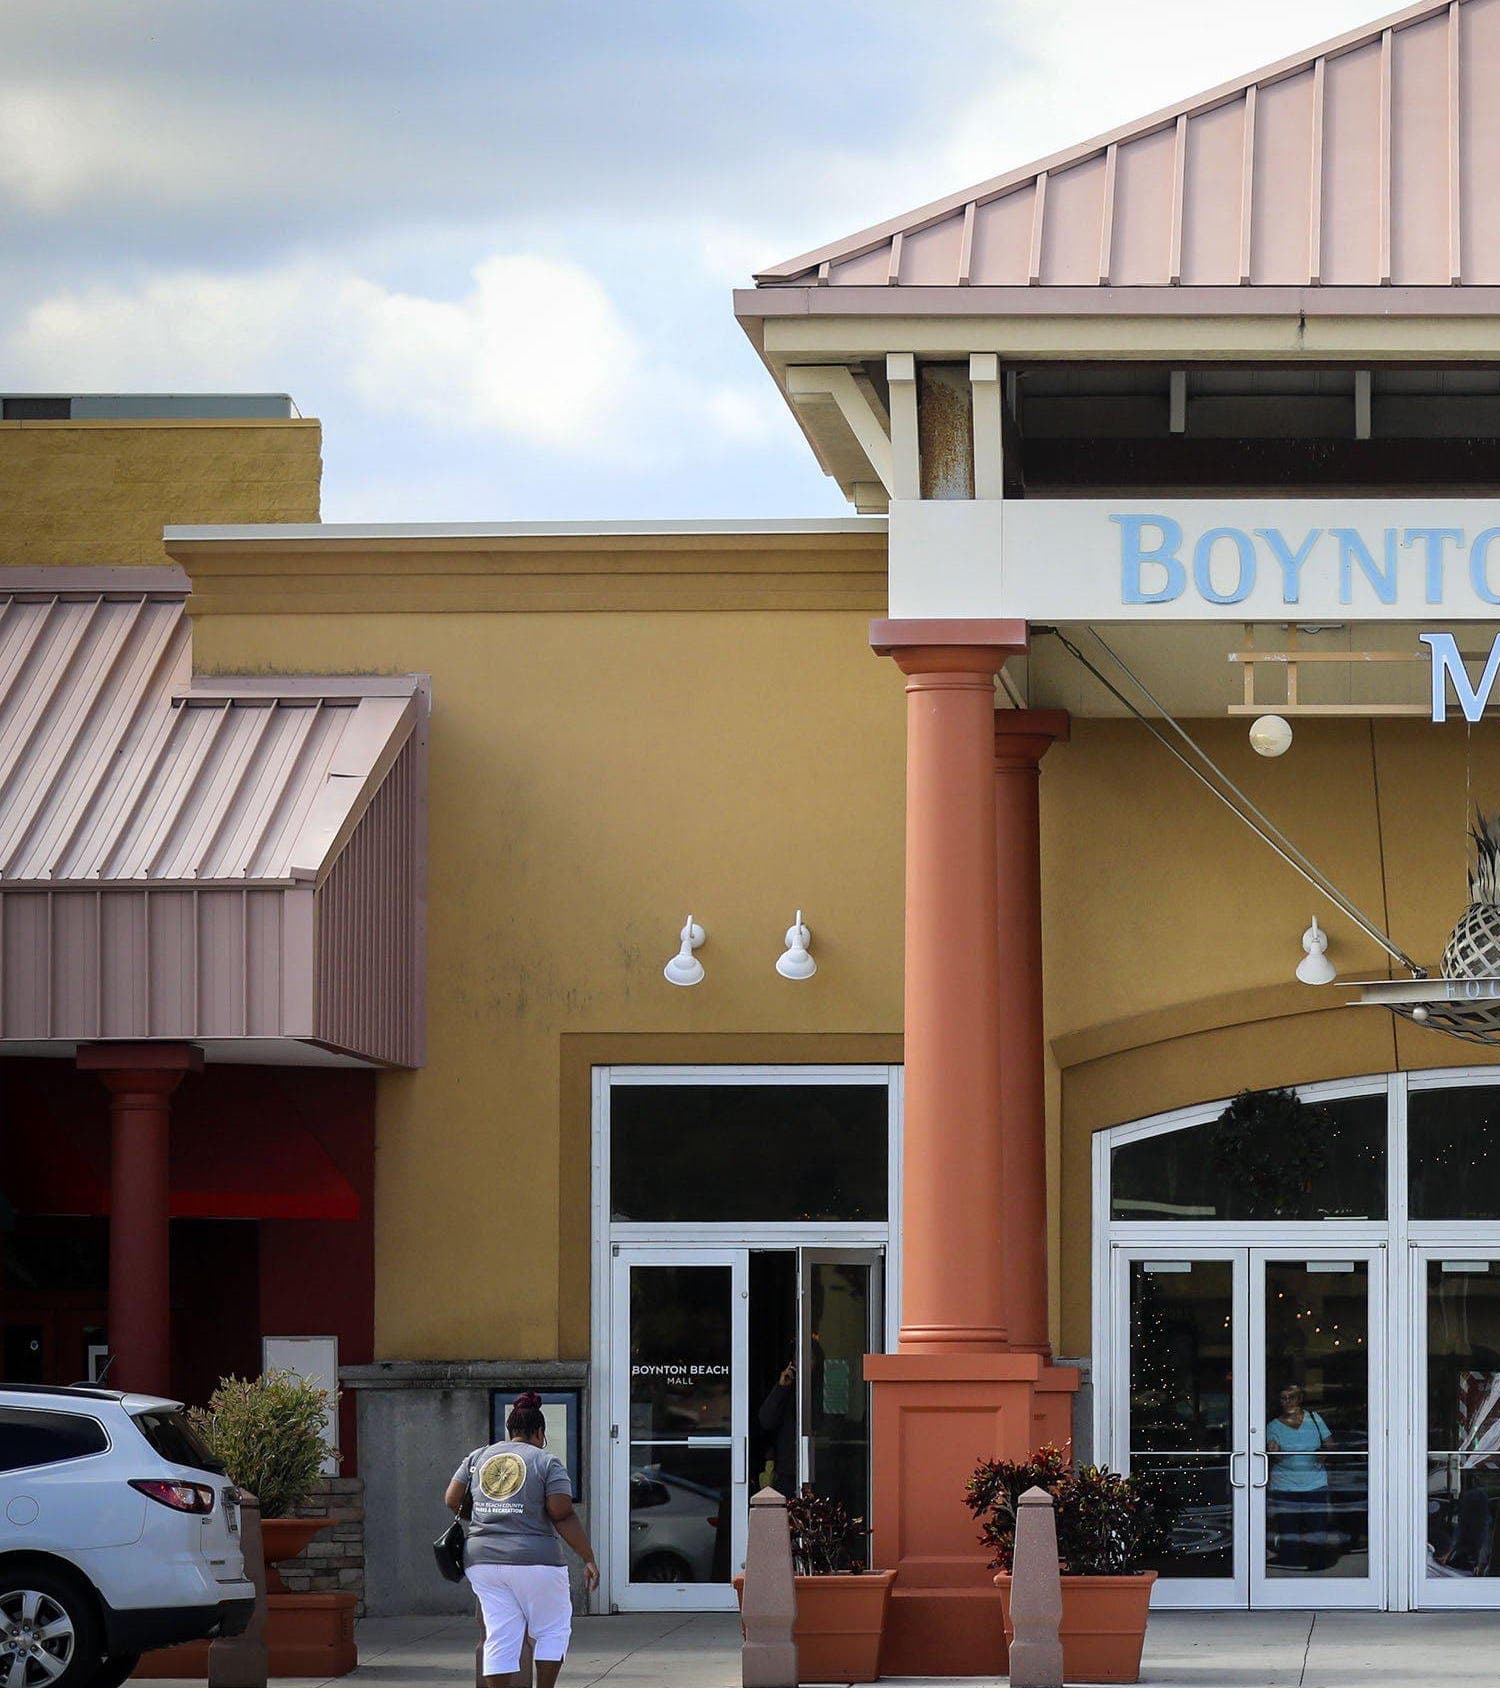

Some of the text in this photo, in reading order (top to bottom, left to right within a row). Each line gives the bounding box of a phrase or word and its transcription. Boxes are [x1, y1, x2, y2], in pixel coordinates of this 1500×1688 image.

[632, 1365, 729, 1375] BOYNTON BEACH
[667, 1377, 694, 1385] MALL
